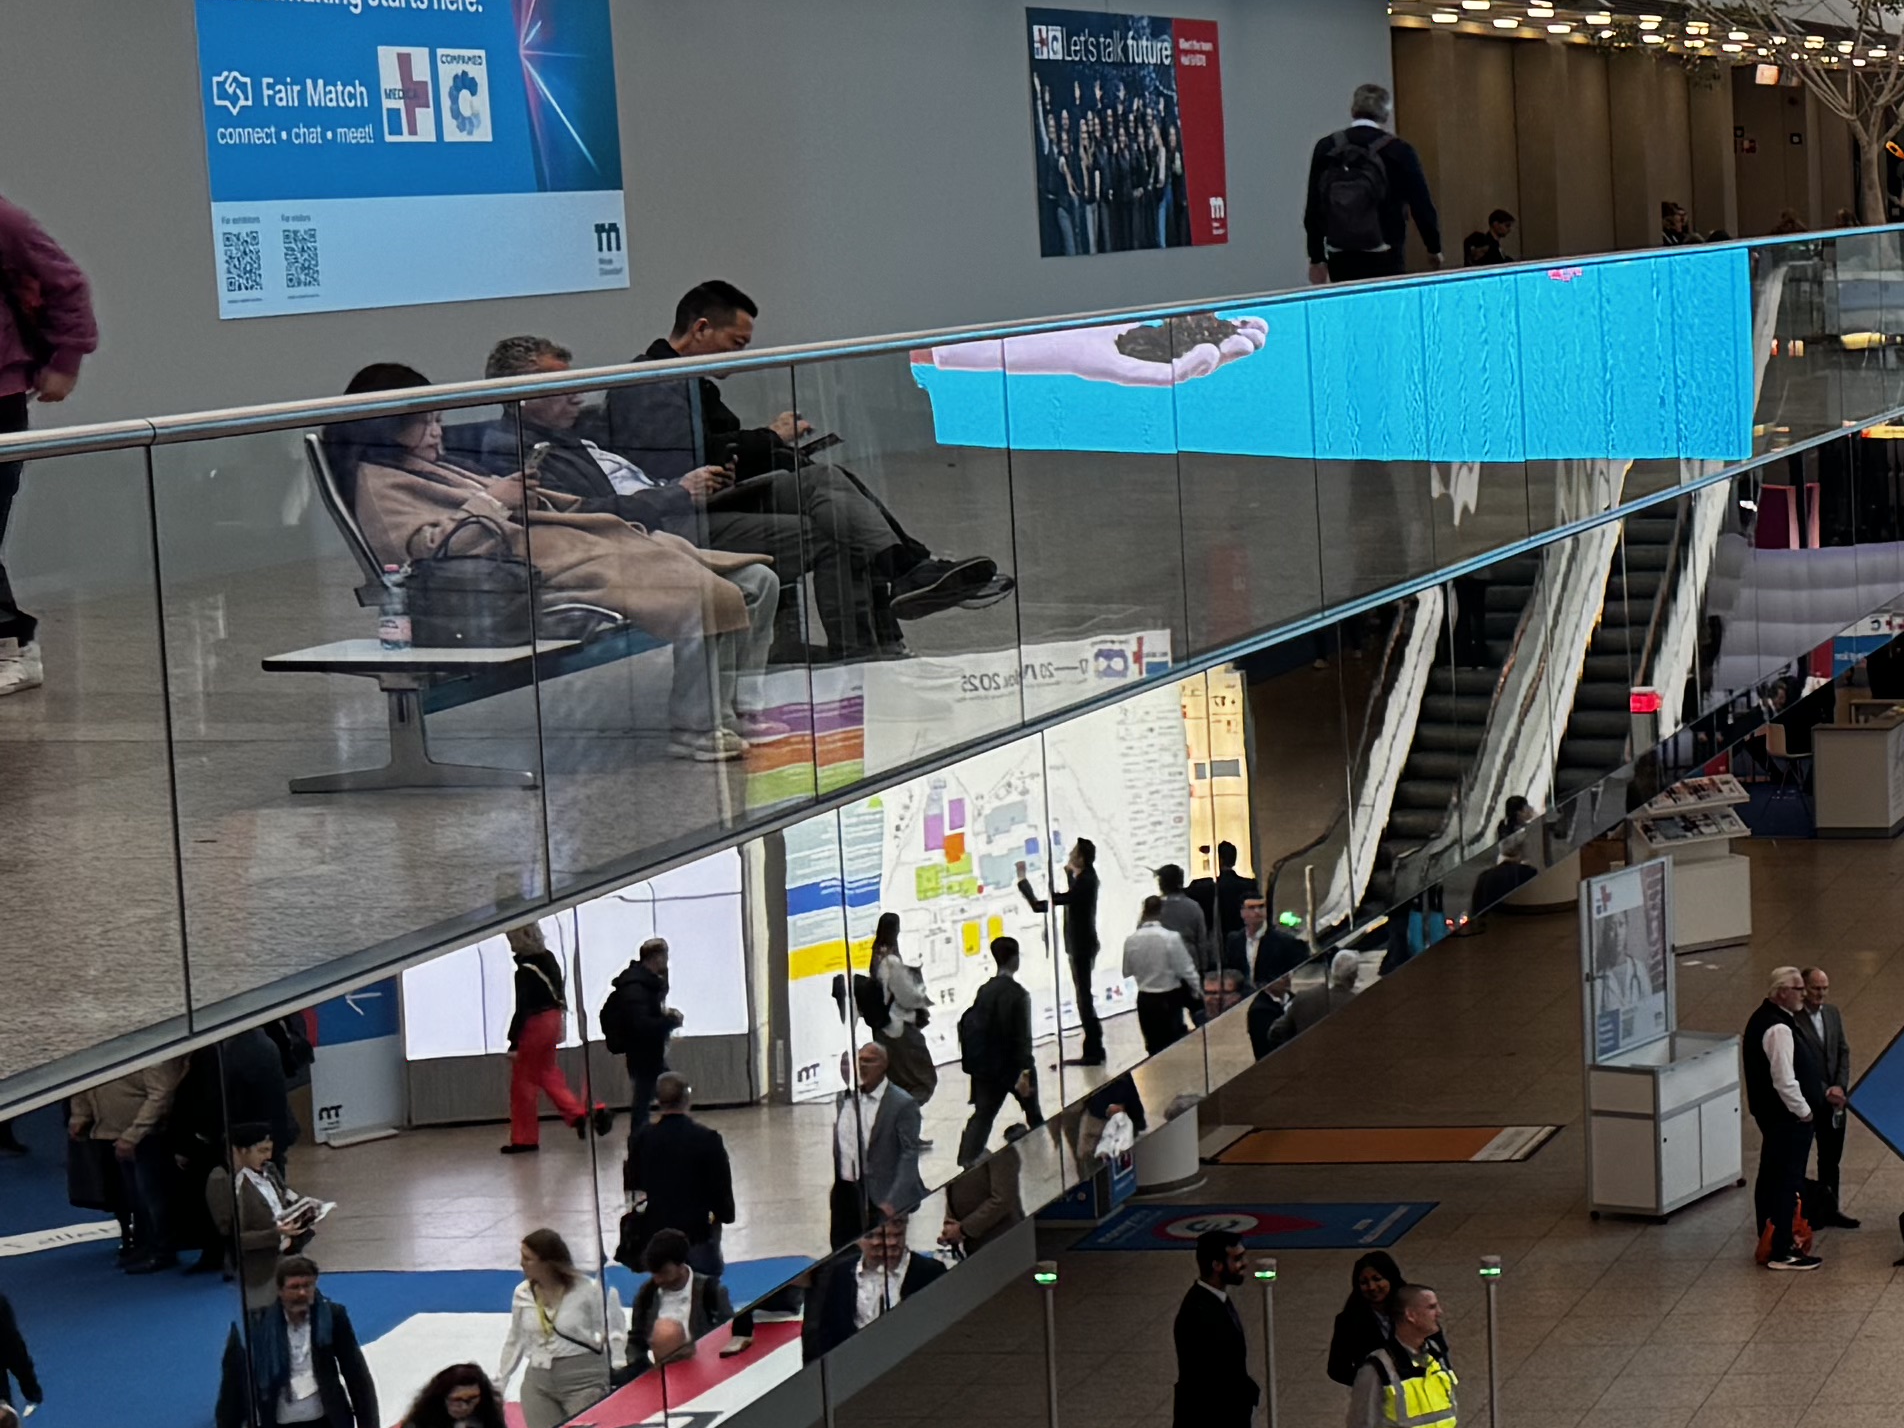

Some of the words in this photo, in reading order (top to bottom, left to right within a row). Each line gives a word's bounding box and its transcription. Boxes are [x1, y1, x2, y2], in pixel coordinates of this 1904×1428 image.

[1062, 28, 1098, 62] Let's
[1100, 29, 1125, 63] talk
[1127, 31, 1172, 66] future
[262, 76, 301, 107] Fair
[306, 77, 369, 109] Match
[217, 126, 276, 145] connect
[291, 123, 322, 144] chat
[337, 122, 374, 145] meet!
